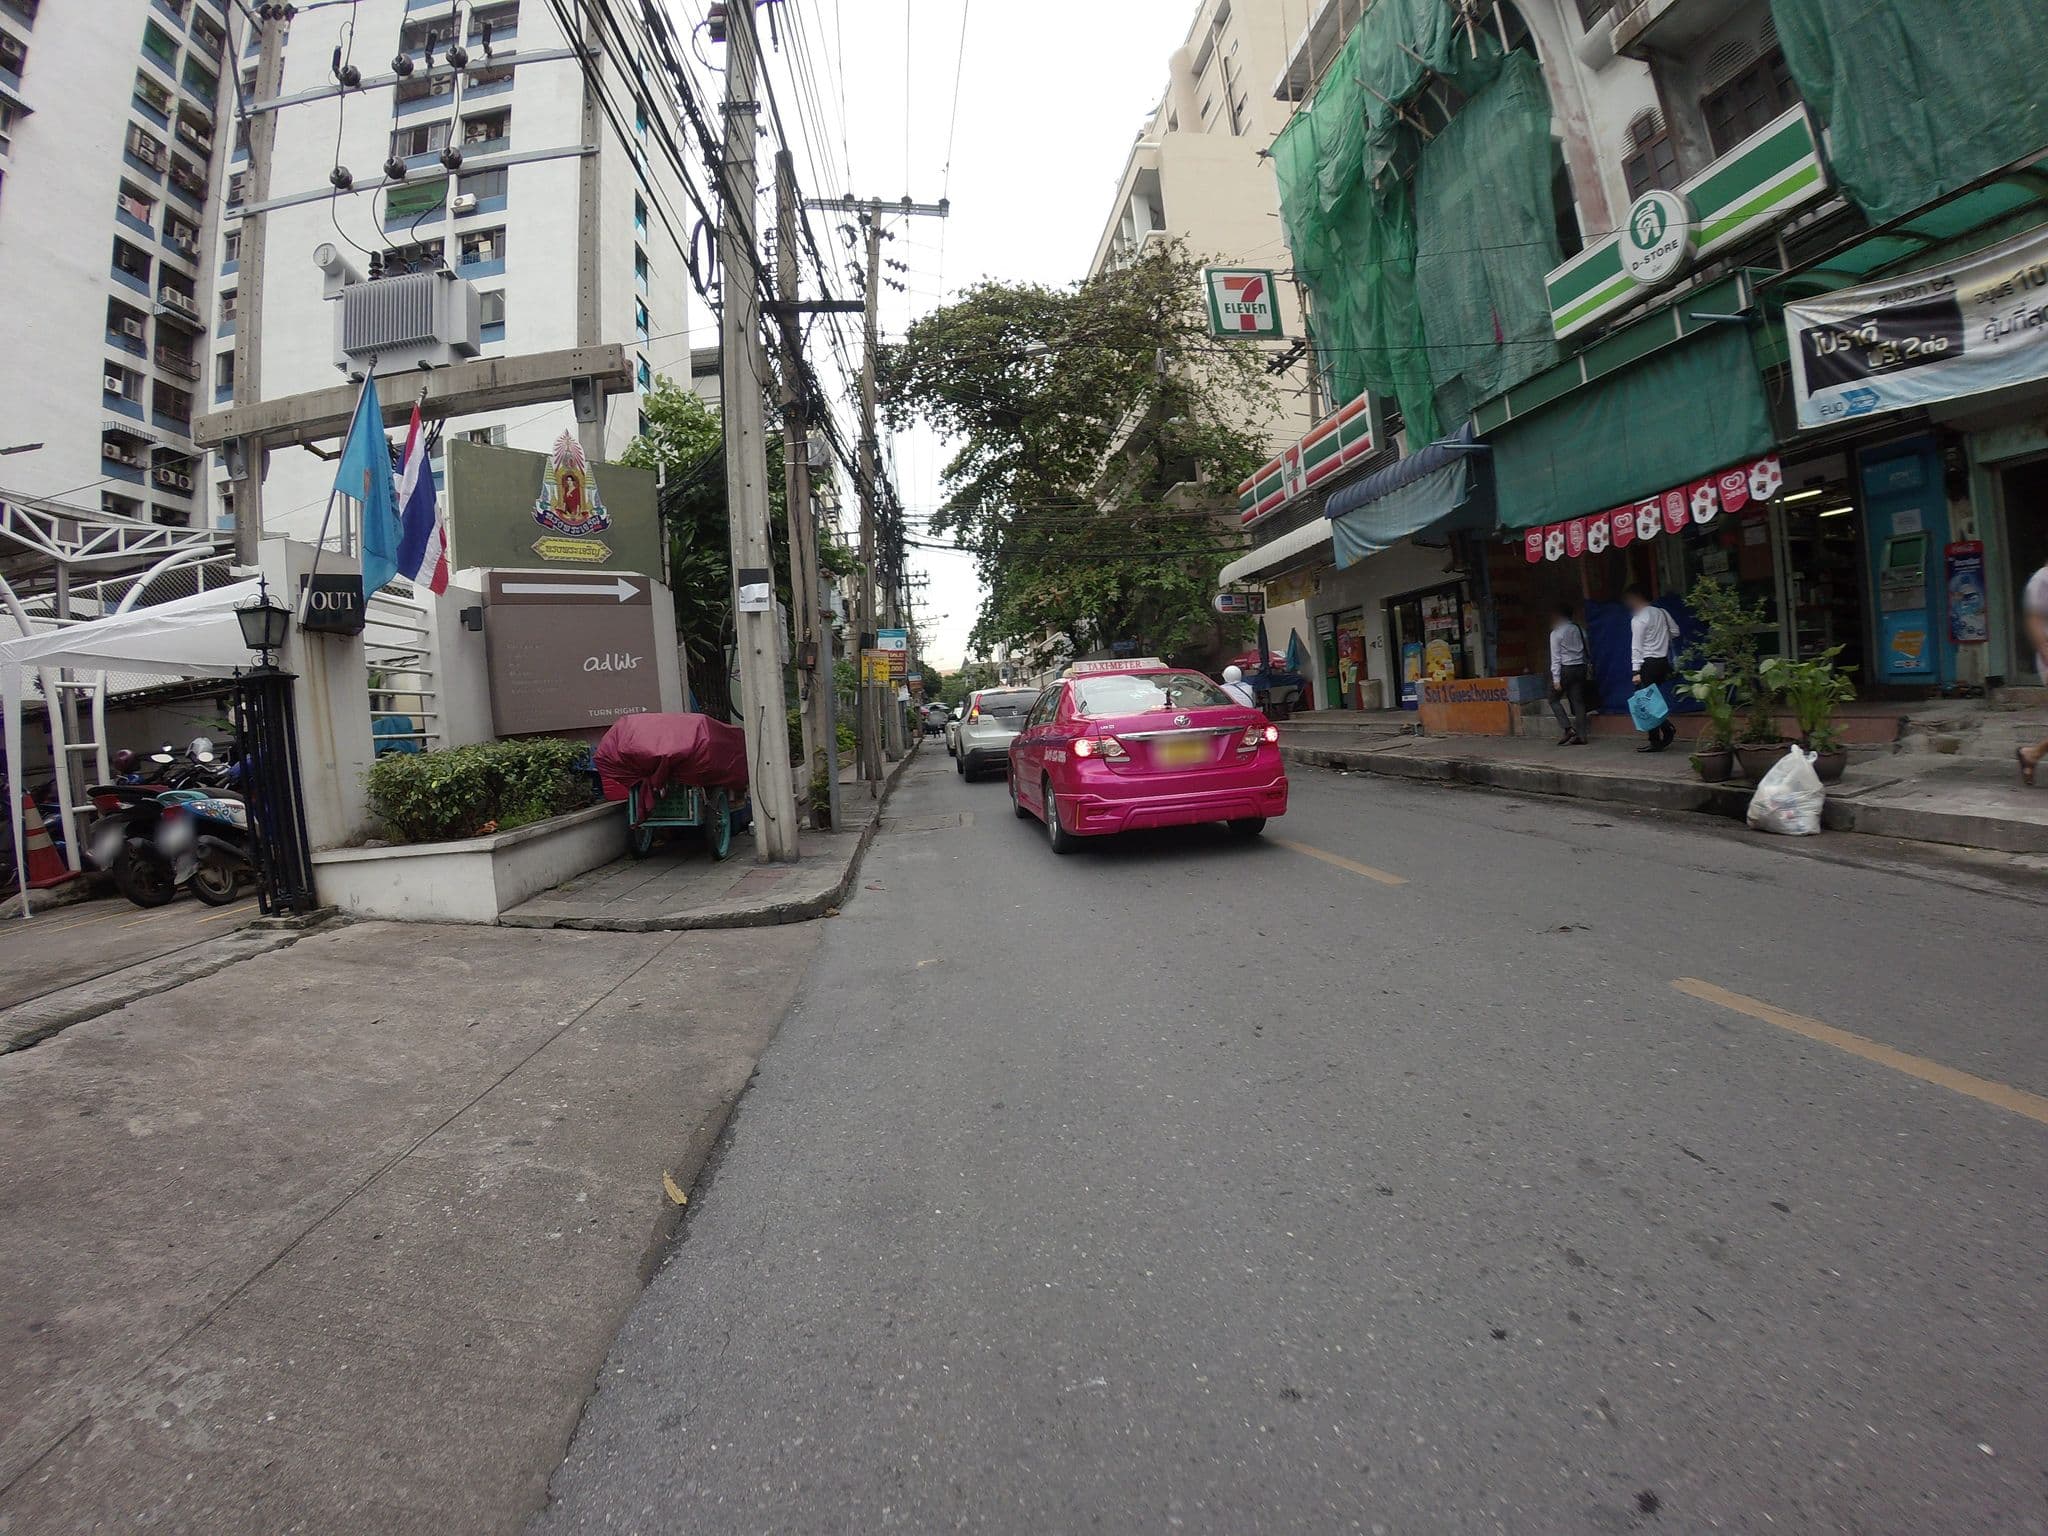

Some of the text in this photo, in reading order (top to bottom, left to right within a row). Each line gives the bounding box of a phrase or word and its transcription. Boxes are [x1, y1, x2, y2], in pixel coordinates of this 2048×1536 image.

[1632, 240, 1679, 271] D-STORE
[1223, 277, 1263, 330] 7
[545, 545, 600, 557] ทรงพระเจริญ
[311, 591, 357, 610] OUT
[583, 653, 612, 672] ad
[1087, 661, 1142, 671] TAXI-METER
[588, 706, 640, 717] TURN RIGHT
